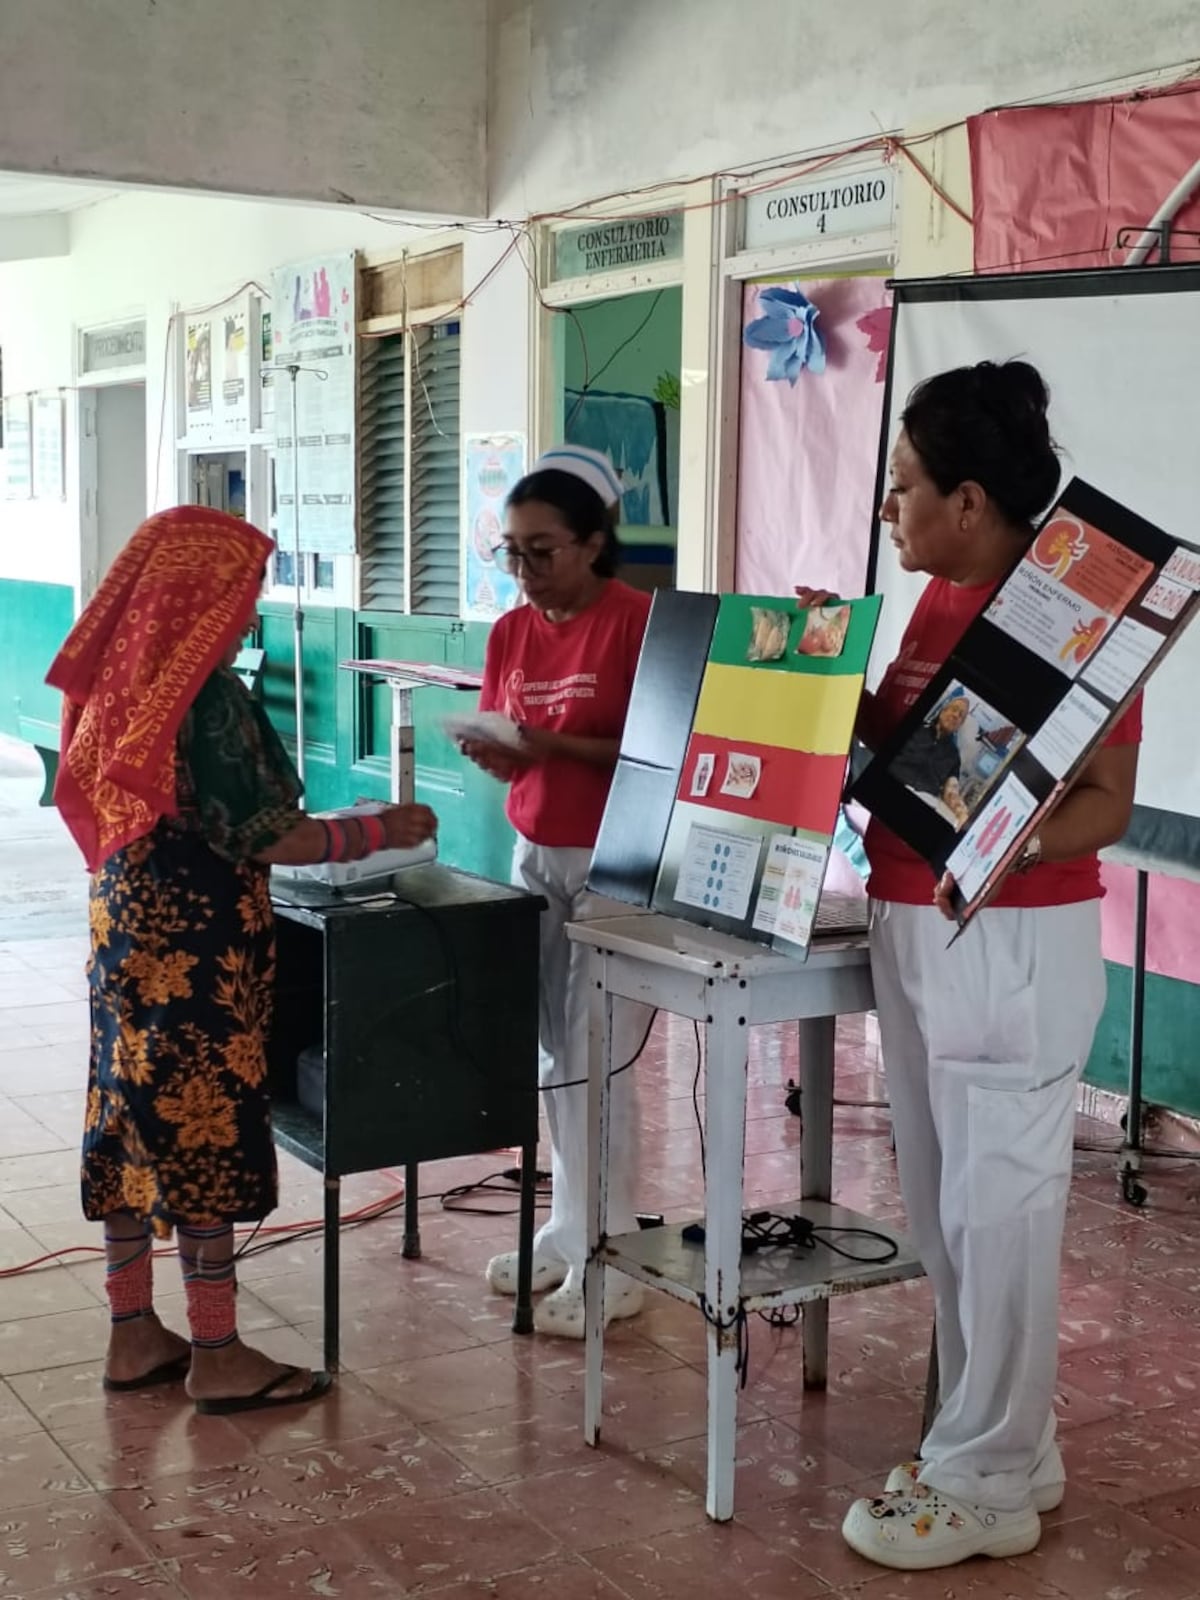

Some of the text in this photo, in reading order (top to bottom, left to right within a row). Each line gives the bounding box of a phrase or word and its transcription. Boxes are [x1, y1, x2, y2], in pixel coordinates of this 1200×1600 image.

[766, 179, 885, 220] CONSULTORIO
[577, 216, 669, 250] CONSULTORIO
[816, 213, 826, 234] 4
[585, 241, 666, 270] ENFERMERIA
[1042, 584, 1082, 612] ENFERMO
